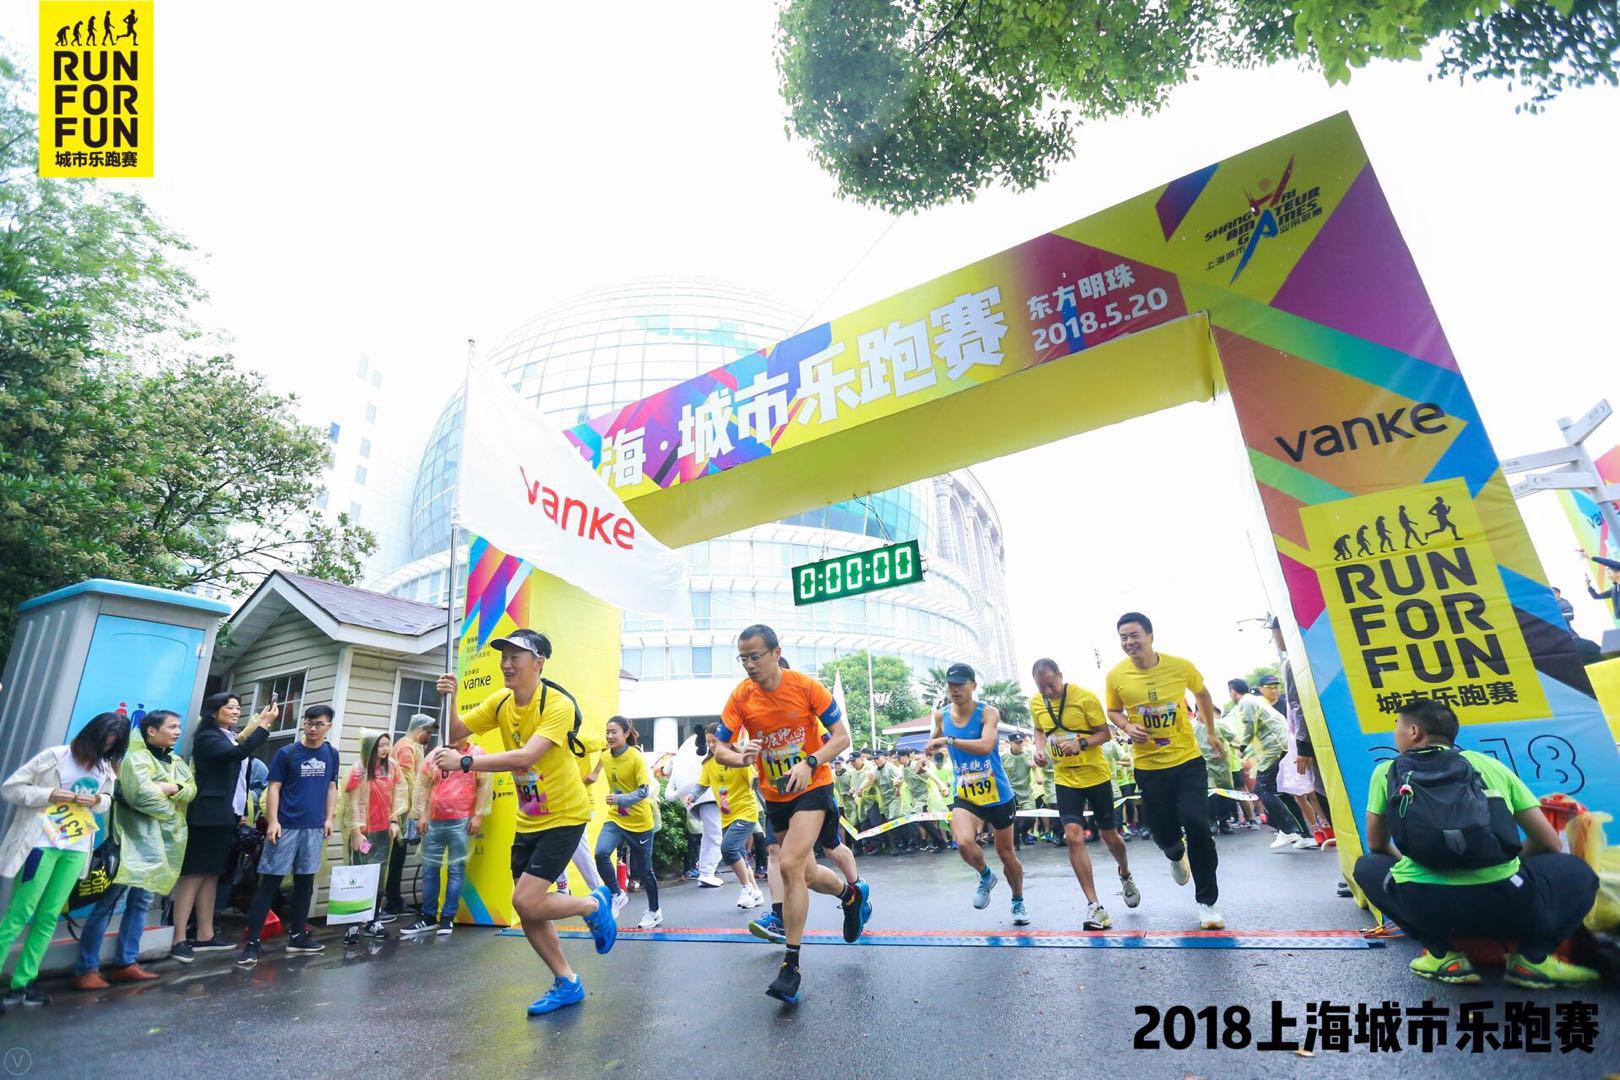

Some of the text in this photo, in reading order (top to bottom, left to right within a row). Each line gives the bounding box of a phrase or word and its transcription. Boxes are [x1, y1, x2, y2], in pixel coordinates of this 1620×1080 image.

[1027, 263, 1136, 321] 东方明珠
[1032, 286, 1169, 352] 2018.5.20
[1275, 402, 1448, 463] vanke
[798, 546, 913, 600] 0:00:00
[1335, 547, 1478, 604] RUN
[1350, 592, 1494, 646] FOR
[463, 674, 492, 690] vanke
[1361, 633, 1511, 689] FUN
[1143, 712, 1177, 729] 0027
[961, 780, 992, 798] 1139
[78, 879, 92, 897] UN
